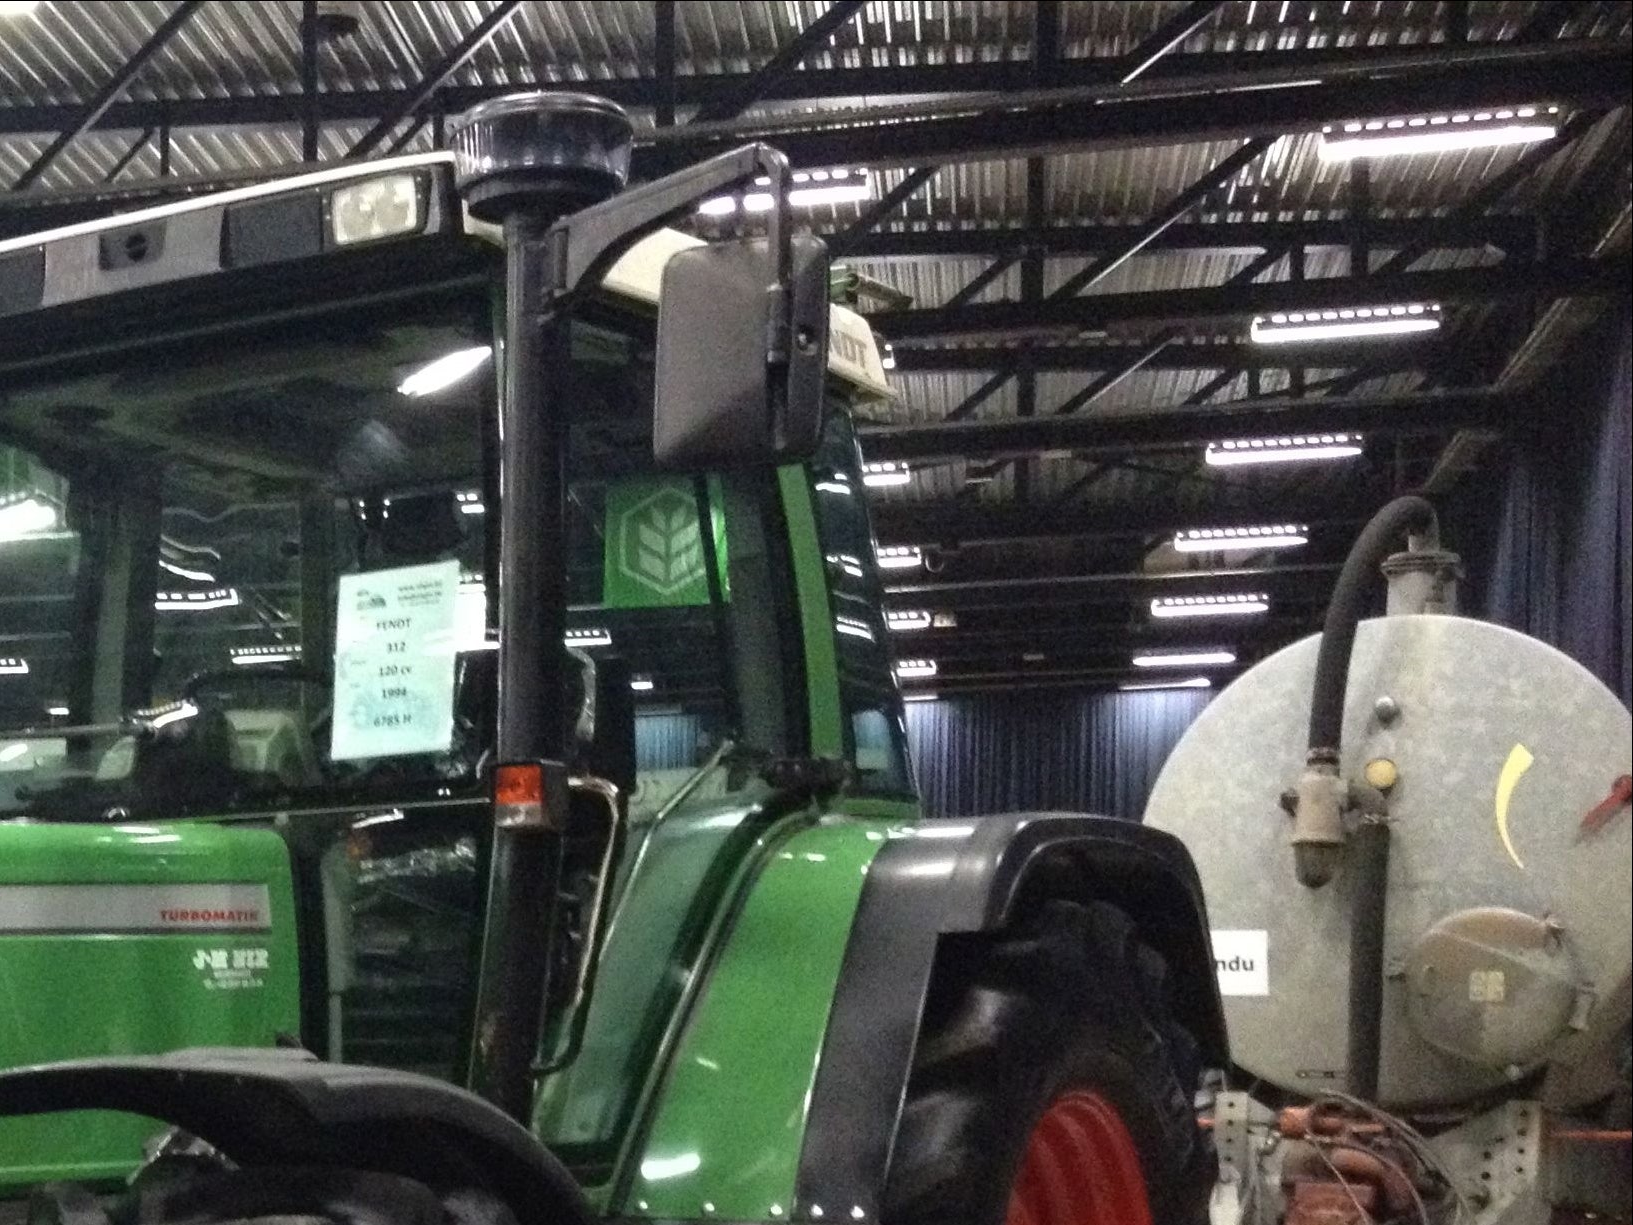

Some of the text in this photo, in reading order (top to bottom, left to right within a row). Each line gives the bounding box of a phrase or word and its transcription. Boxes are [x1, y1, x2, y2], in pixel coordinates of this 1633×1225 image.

[375, 617, 412, 631] FENDT
[379, 664, 400, 677] 120
[1216, 956, 1255, 971] ndu
